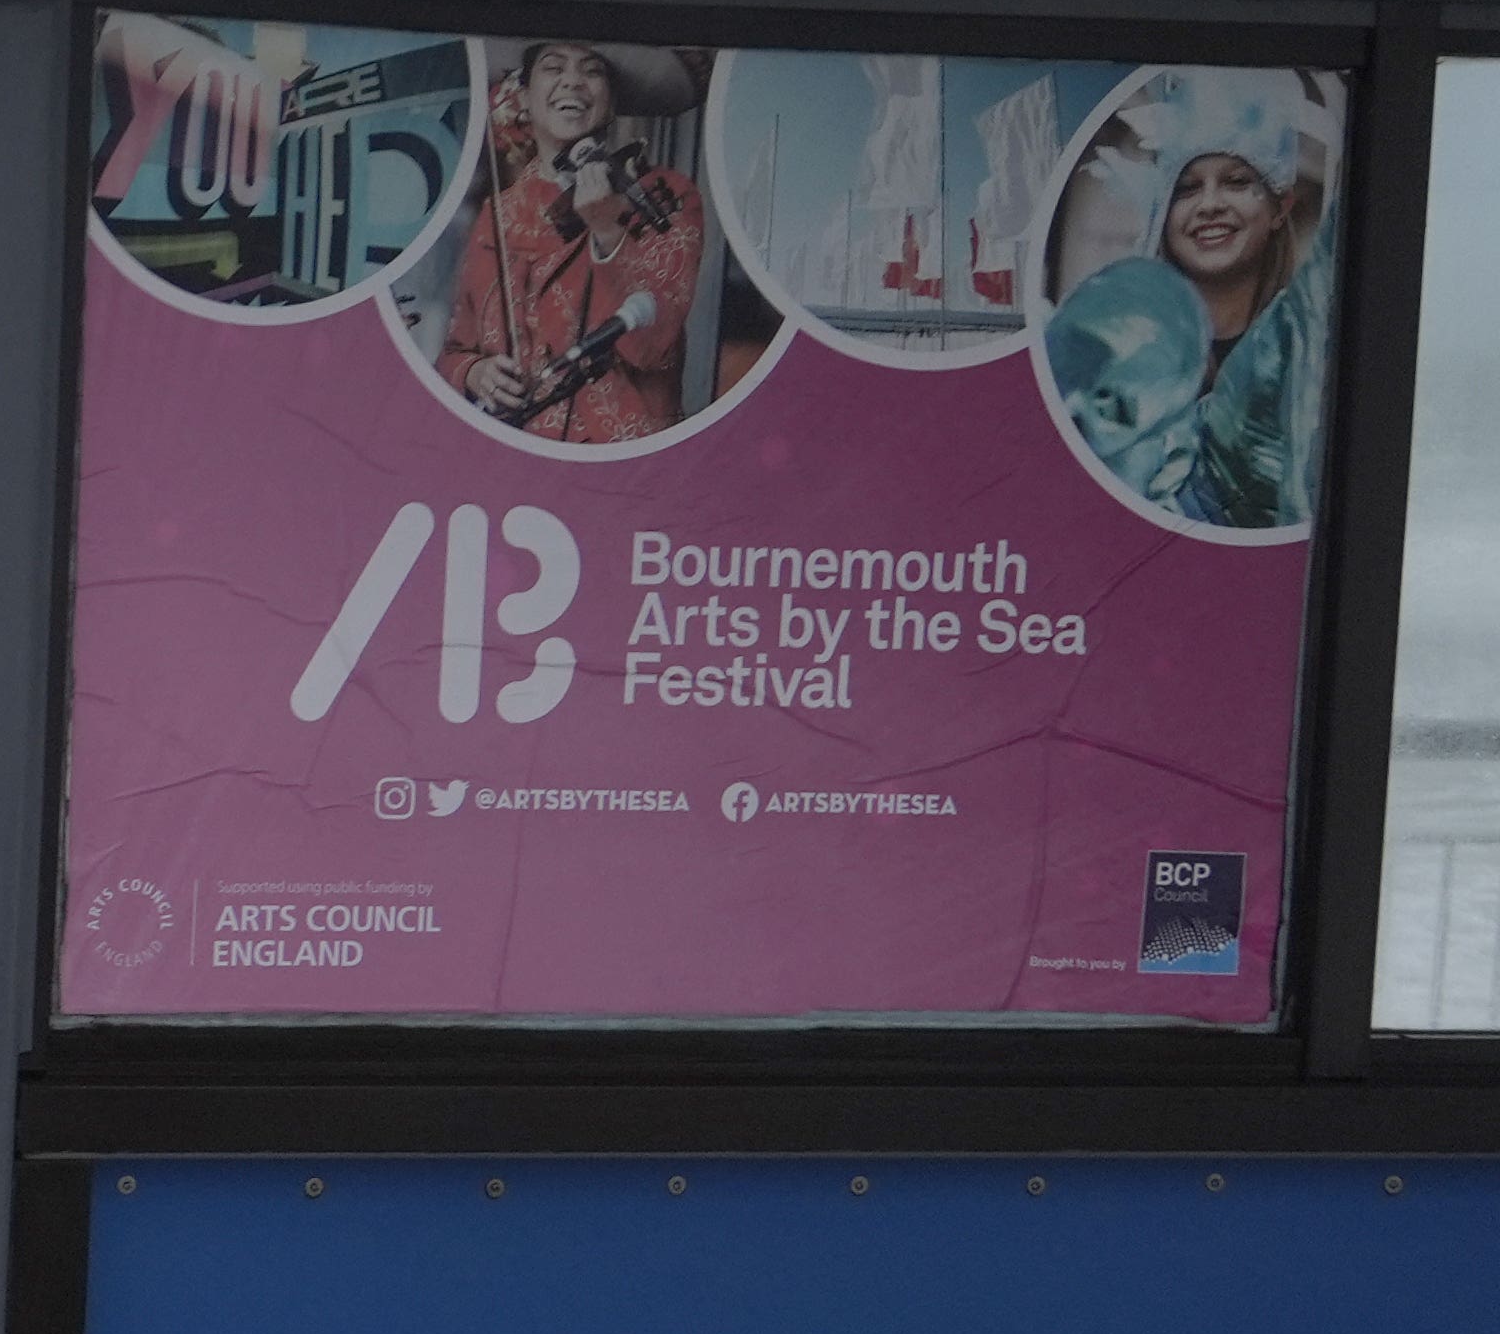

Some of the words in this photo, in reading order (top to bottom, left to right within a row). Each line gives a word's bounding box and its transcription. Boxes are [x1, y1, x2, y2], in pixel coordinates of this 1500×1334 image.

[630, 530, 1028, 595] Bournemouth
[627, 591, 761, 647] Arts
[779, 593, 851, 664] by
[865, 595, 961, 652] the
[976, 598, 1088, 656] Sea
[623, 651, 853, 709] Festival
[474, 787, 691, 813] @ARTSBYTHESEA
[764, 791, 958, 817] ARTSBYTHESEA
[1155, 861, 1211, 886] BCP
[217, 880, 285, 896] Supported
[287, 881, 322, 896] using
[323, 880, 363, 895] public
[365, 881, 416, 897] funding
[417, 882, 434, 897] by
[1153, 887, 1209, 903] Council
[86, 887, 114, 930] ARTS
[215, 904, 297, 932] ARTS
[305, 904, 442, 933] COUNCIL
[212, 939, 364, 968] ENGLAND
